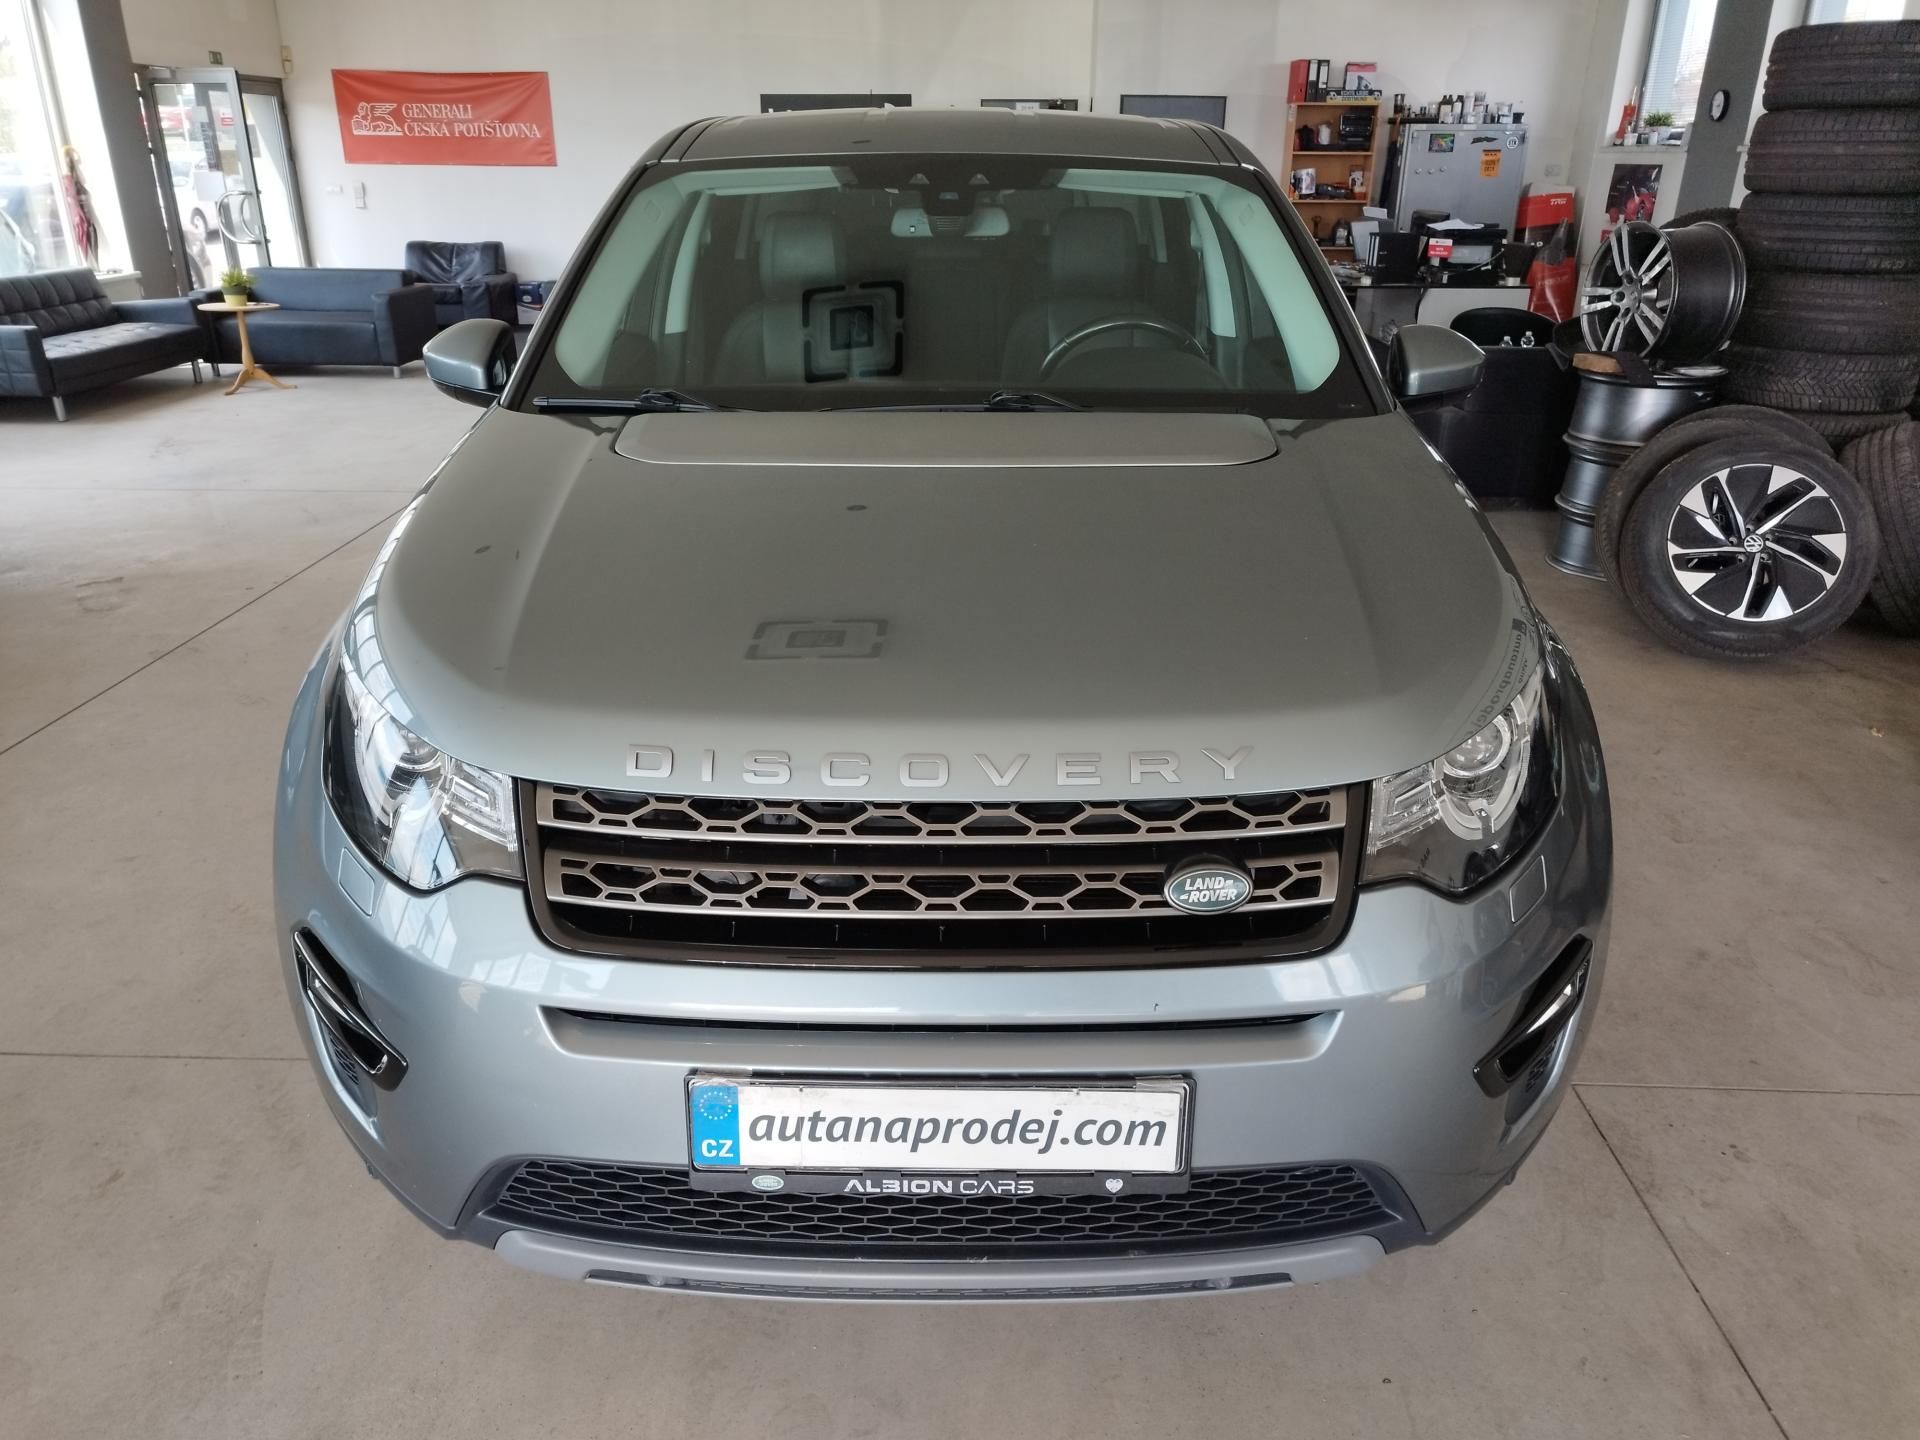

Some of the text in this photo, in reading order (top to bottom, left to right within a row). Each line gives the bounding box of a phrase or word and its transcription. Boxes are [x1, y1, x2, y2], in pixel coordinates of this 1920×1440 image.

[402, 103, 472, 119] GENERALI
[404, 119, 542, 138] ČESKÁ POJIŠŤOVNA
[626, 744, 1254, 787] DISCOVERY
[1184, 877, 1225, 890] LAND
[1188, 888, 1238, 903] ROVER
[749, 1109, 1167, 1154] autanaprodej.com
[701, 1139, 734, 1158] CZ
[843, 1179, 1034, 1195] ALBION CARS
